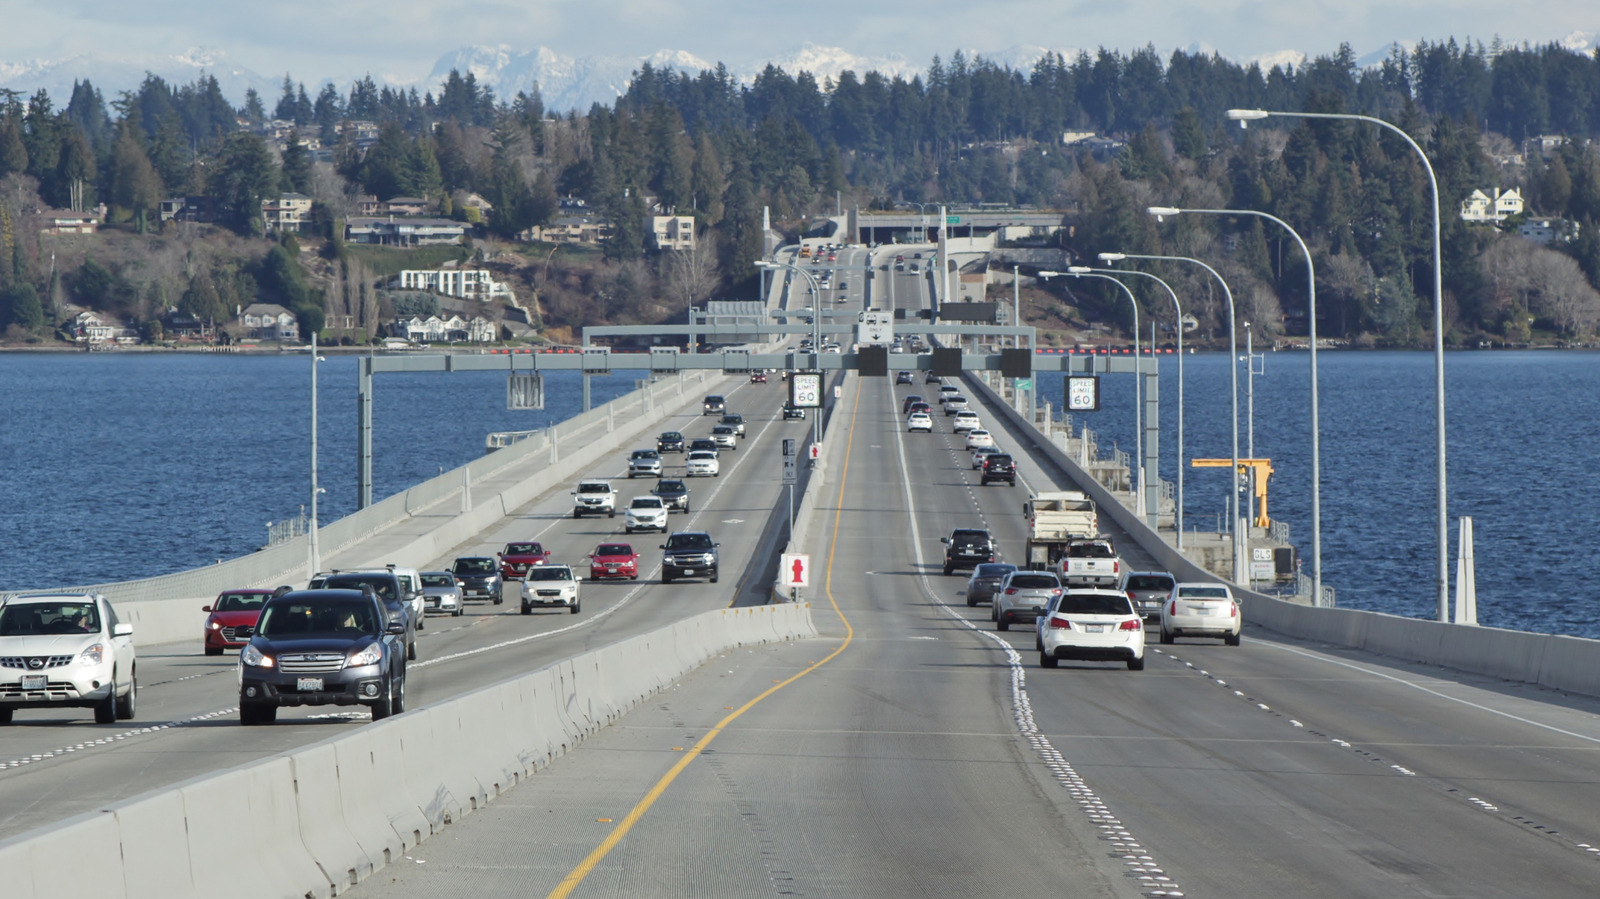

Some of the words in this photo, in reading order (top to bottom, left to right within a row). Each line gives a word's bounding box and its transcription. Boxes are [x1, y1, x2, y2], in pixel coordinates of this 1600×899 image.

[798, 392, 814, 402] 60
[1074, 395, 1090, 405] 60
[1254, 549, 1271, 559] GLS
